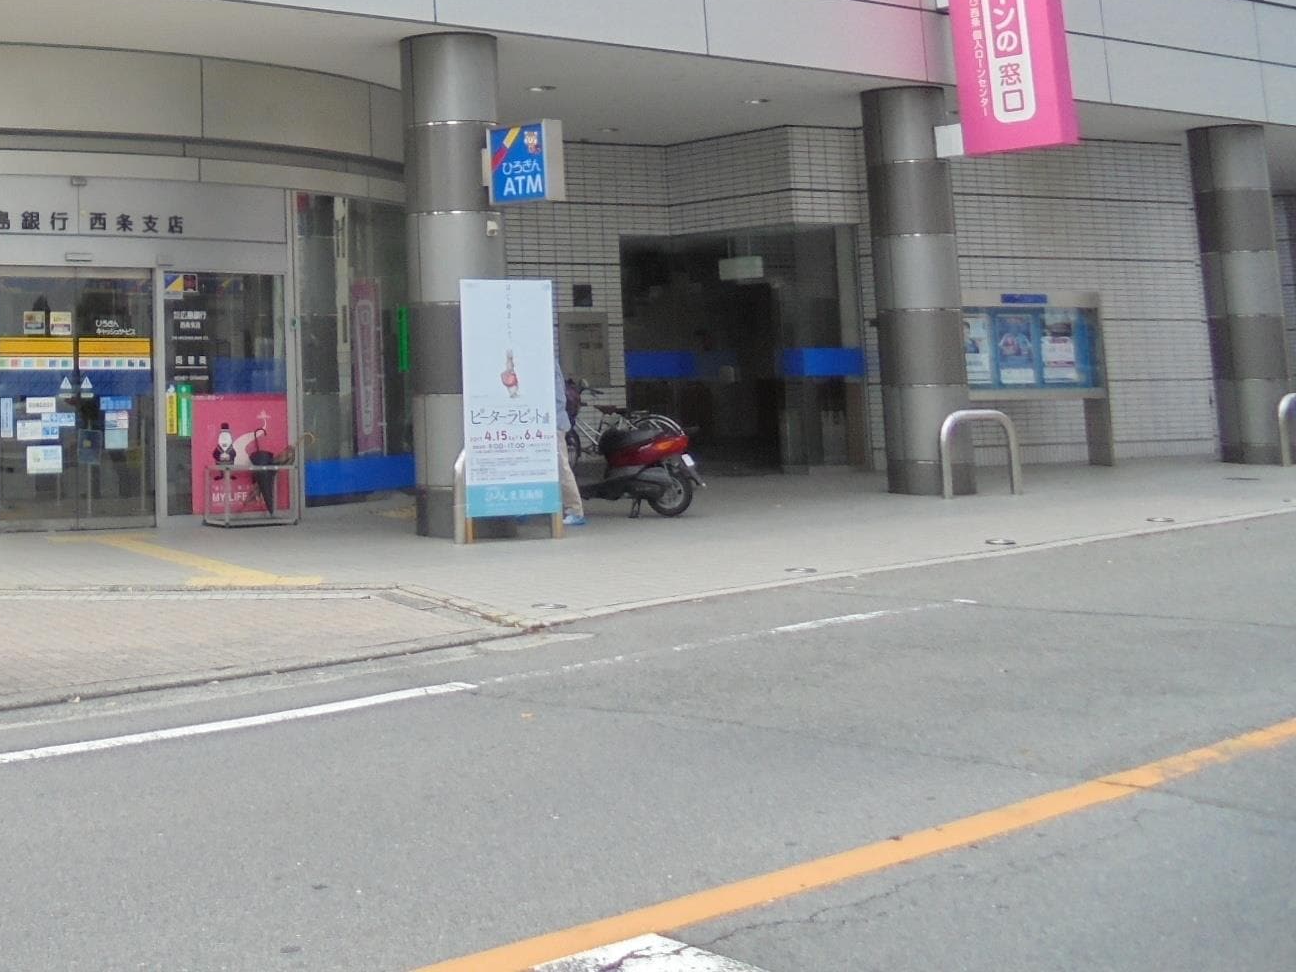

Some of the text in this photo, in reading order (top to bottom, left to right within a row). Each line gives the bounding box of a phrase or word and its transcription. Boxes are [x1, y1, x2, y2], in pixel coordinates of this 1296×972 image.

[502, 158, 542, 176] ひろぎん
[503, 174, 544, 197] ATM
[89, 211, 184, 234] 西条支店
[484, 430, 508, 441] 4.15
[524, 429, 544, 440] 6.4
